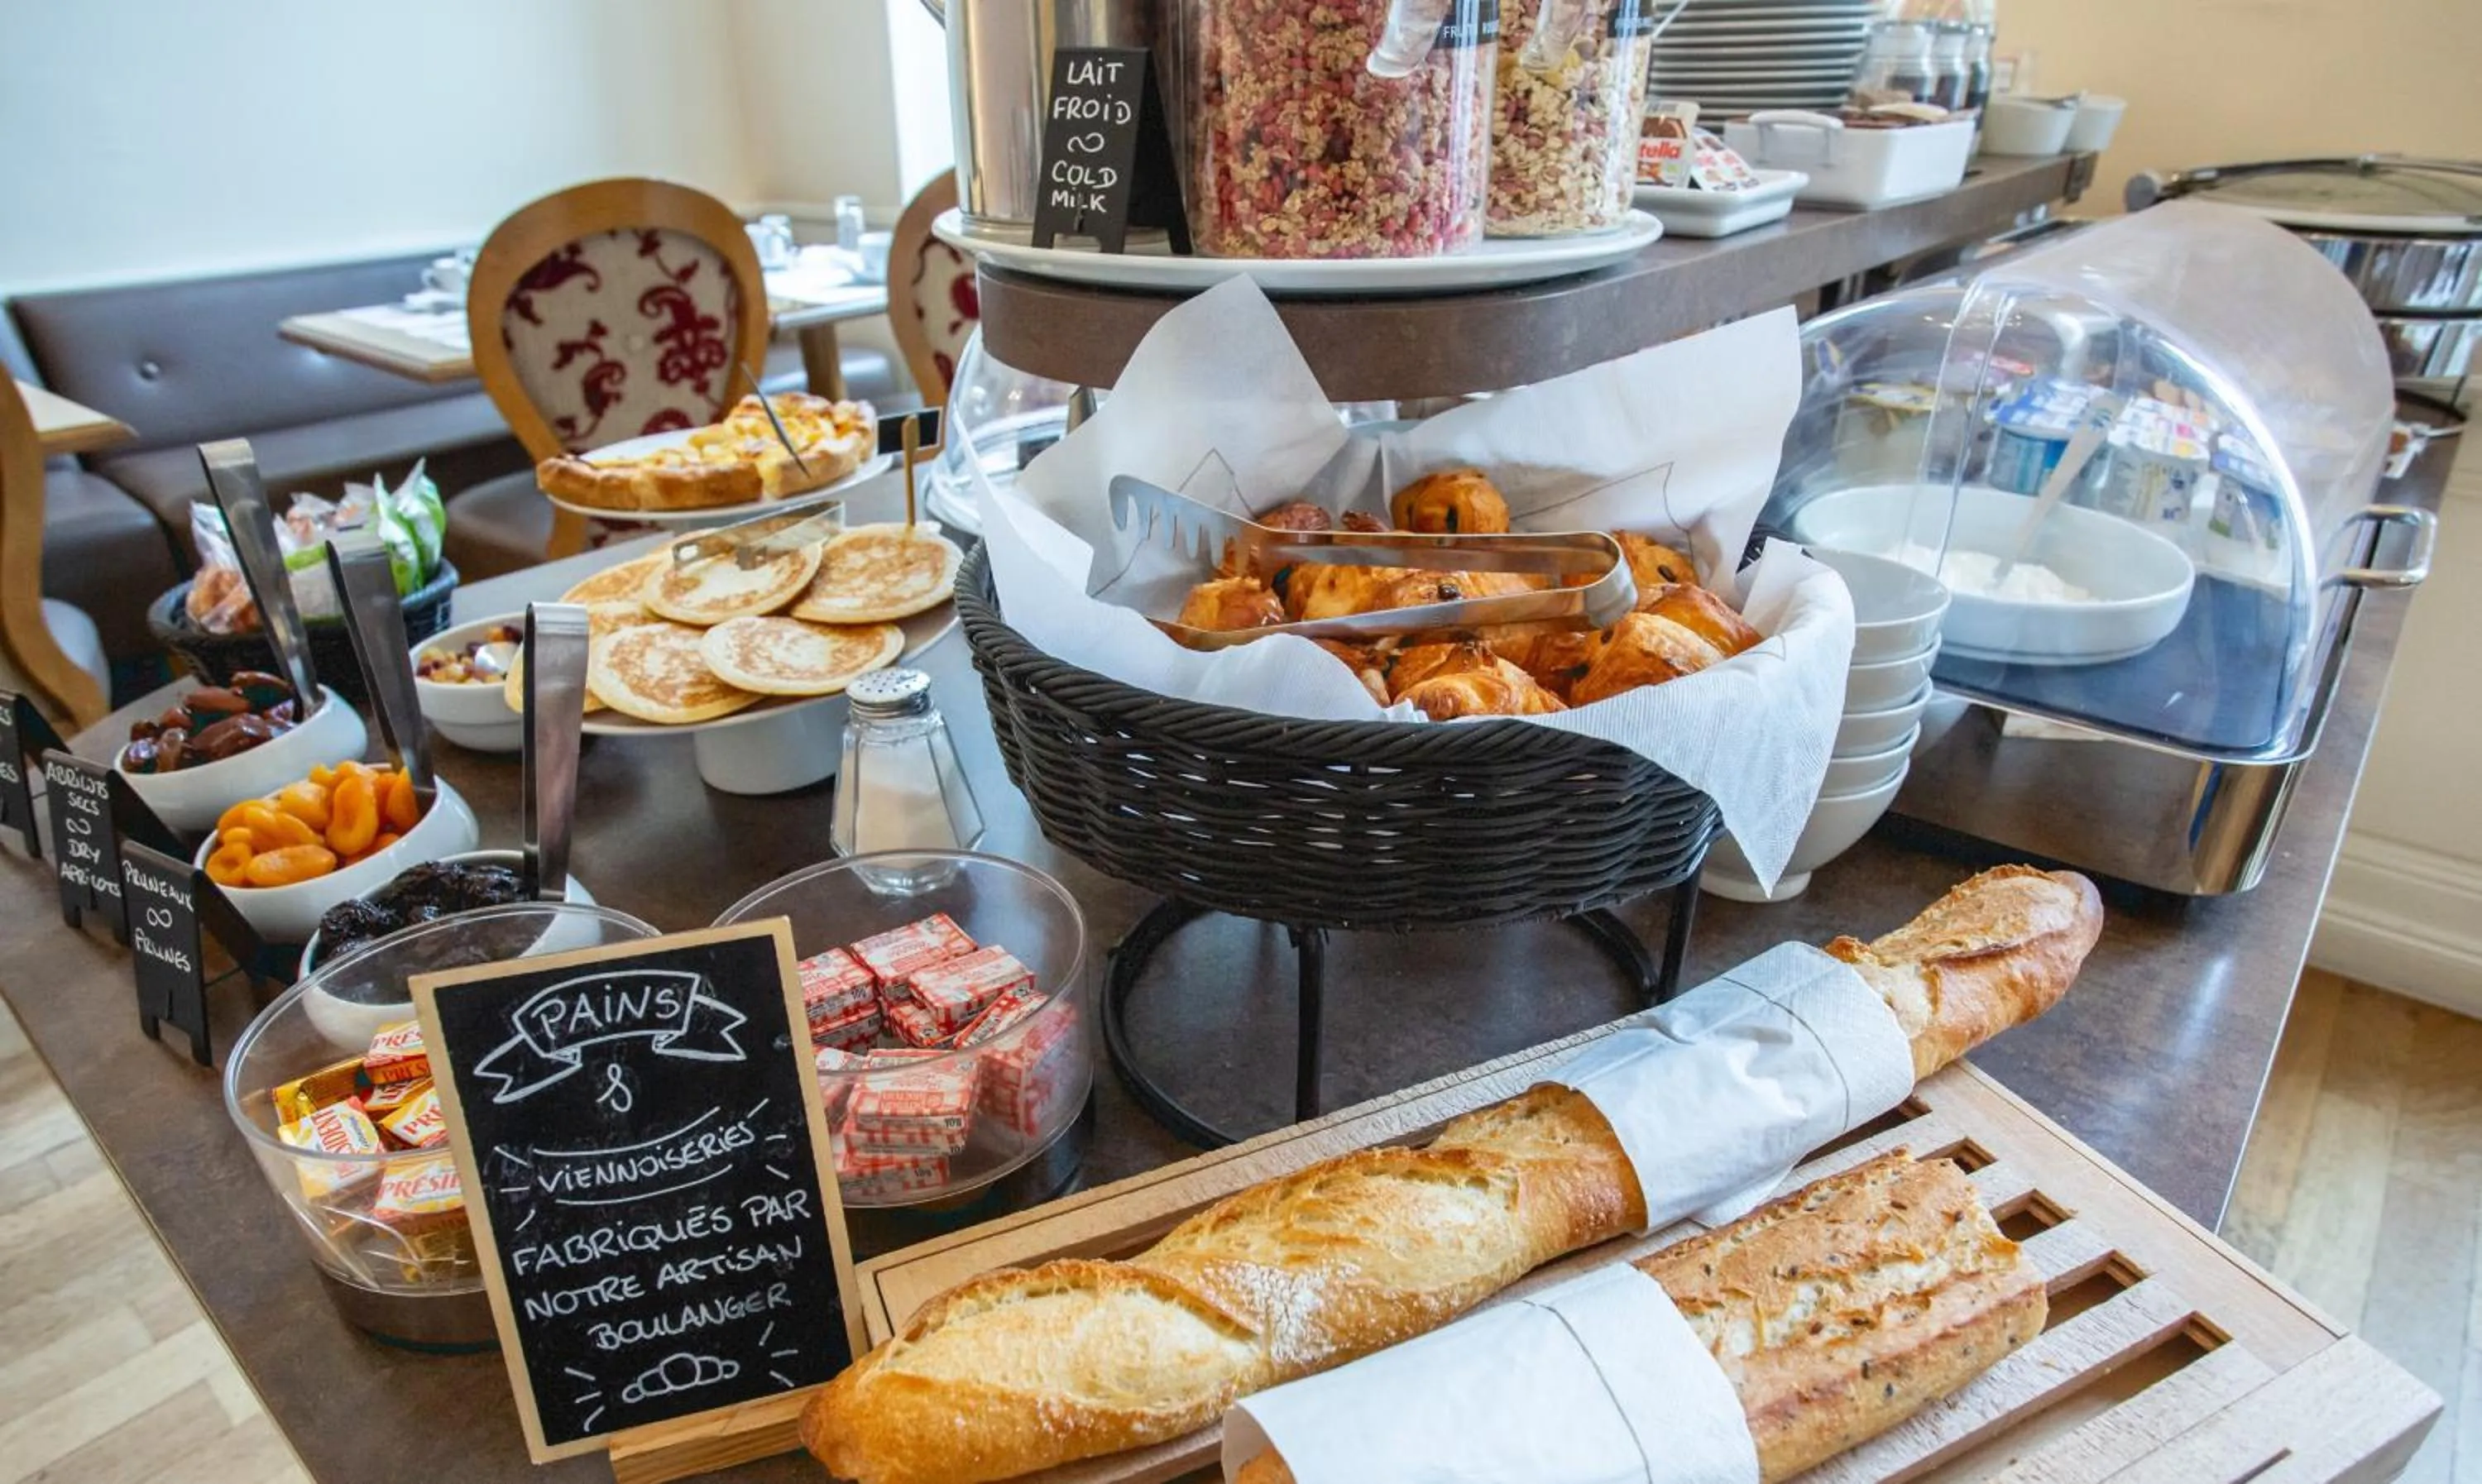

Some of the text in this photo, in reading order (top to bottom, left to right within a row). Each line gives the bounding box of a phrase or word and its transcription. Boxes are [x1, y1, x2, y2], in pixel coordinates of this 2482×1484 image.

[1639, 140, 1681, 160] tella
[1051, 160, 1119, 189] COLD
[67, 838, 100, 864] DRY
[122, 859, 194, 913] PRUNEAUX
[134, 926, 192, 974] PRUNES
[740, 1188, 812, 1228] PAR
[524, 1275, 646, 1321] NOTRE
[587, 1282, 792, 1351] BOULANGER
